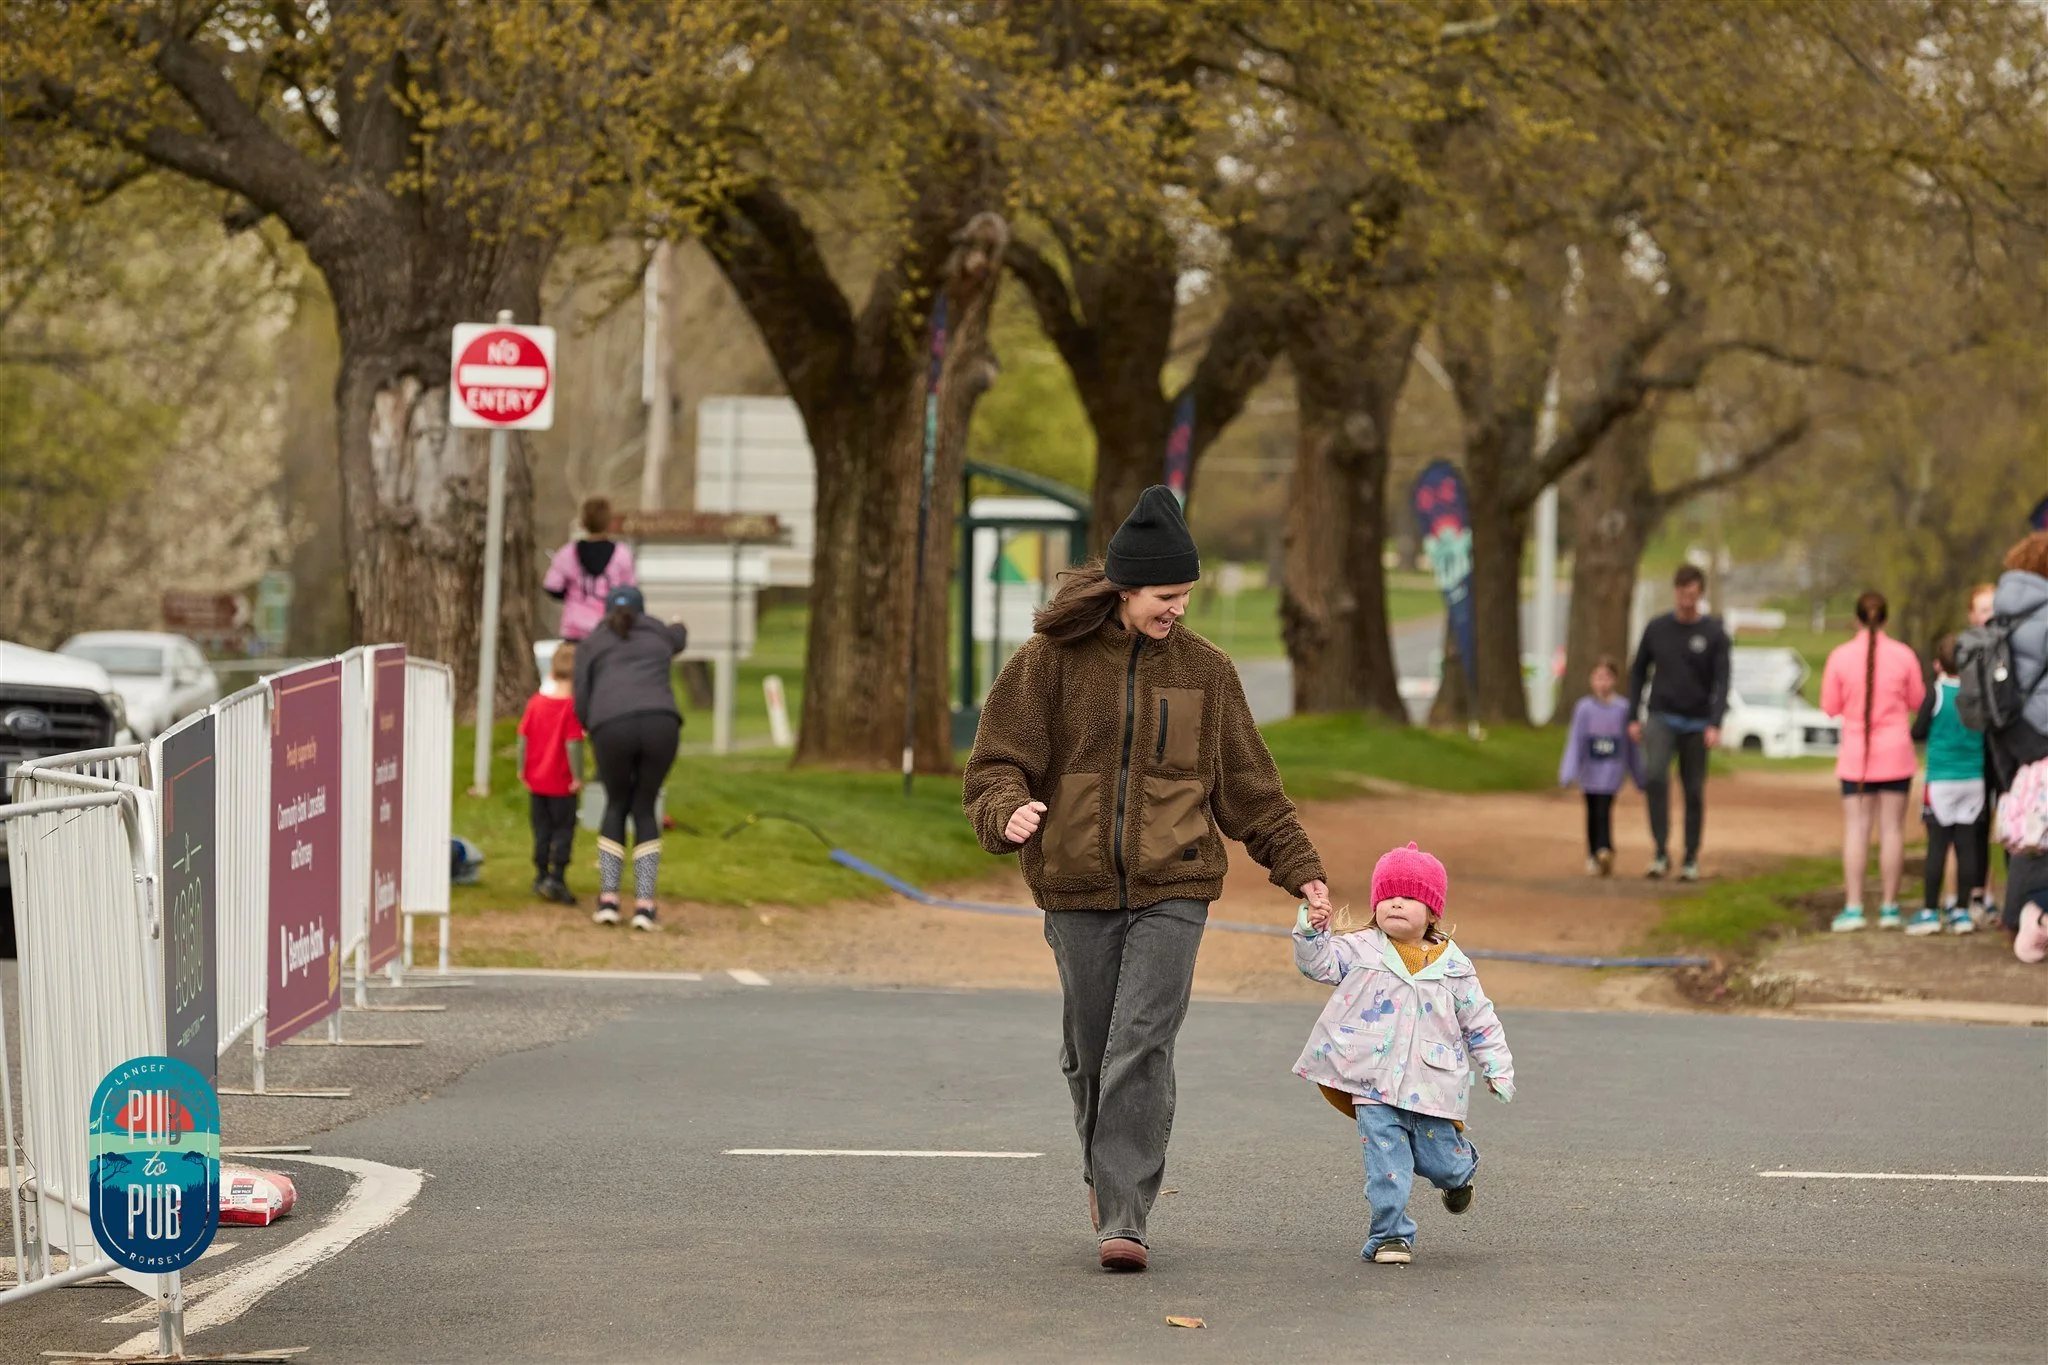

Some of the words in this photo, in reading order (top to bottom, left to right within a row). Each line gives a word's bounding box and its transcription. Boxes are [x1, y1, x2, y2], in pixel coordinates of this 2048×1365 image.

[487, 341, 521, 365] NO
[466, 388, 537, 413] ENTRY
[288, 925, 310, 978] Bendigo
[309, 915, 325, 961] Bank
